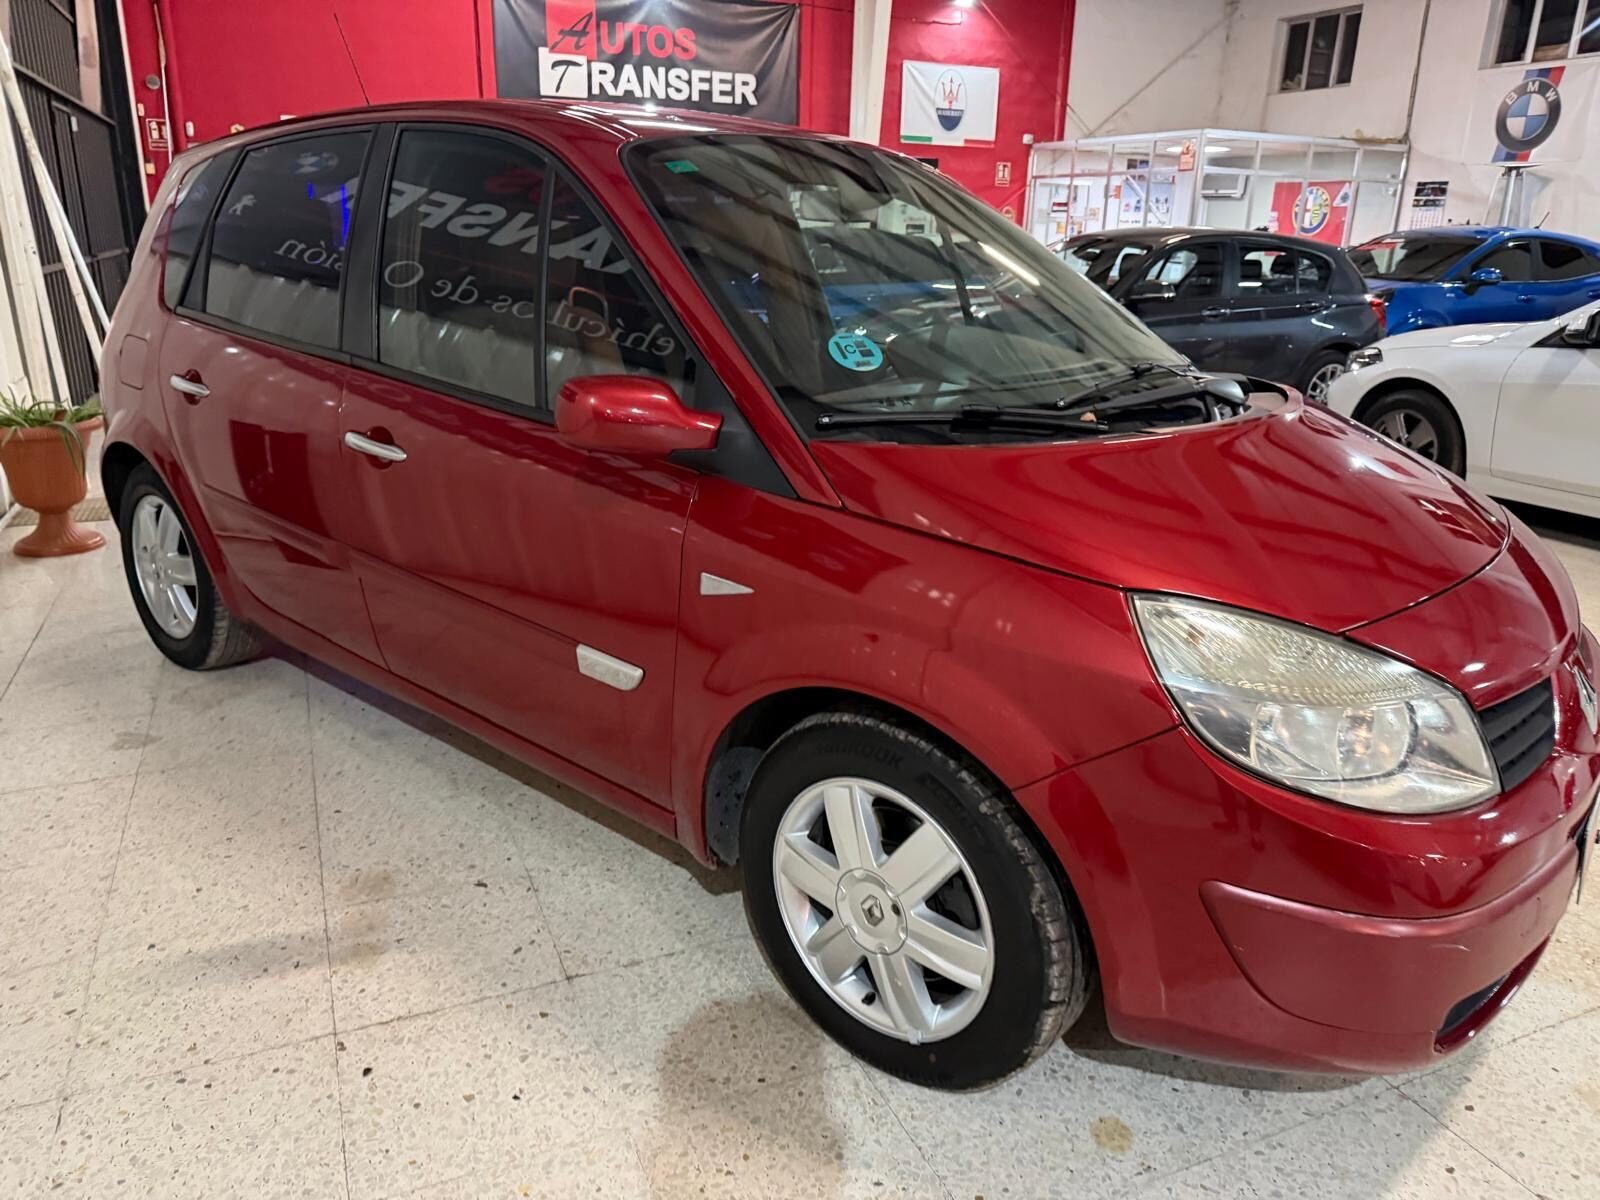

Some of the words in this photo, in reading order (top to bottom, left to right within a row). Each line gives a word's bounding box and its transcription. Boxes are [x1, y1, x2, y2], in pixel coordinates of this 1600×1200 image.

[551, 11, 696, 61] AUTOS
[551, 60, 758, 106] TRANSFER
[1506, 81, 1558, 104] BMW
